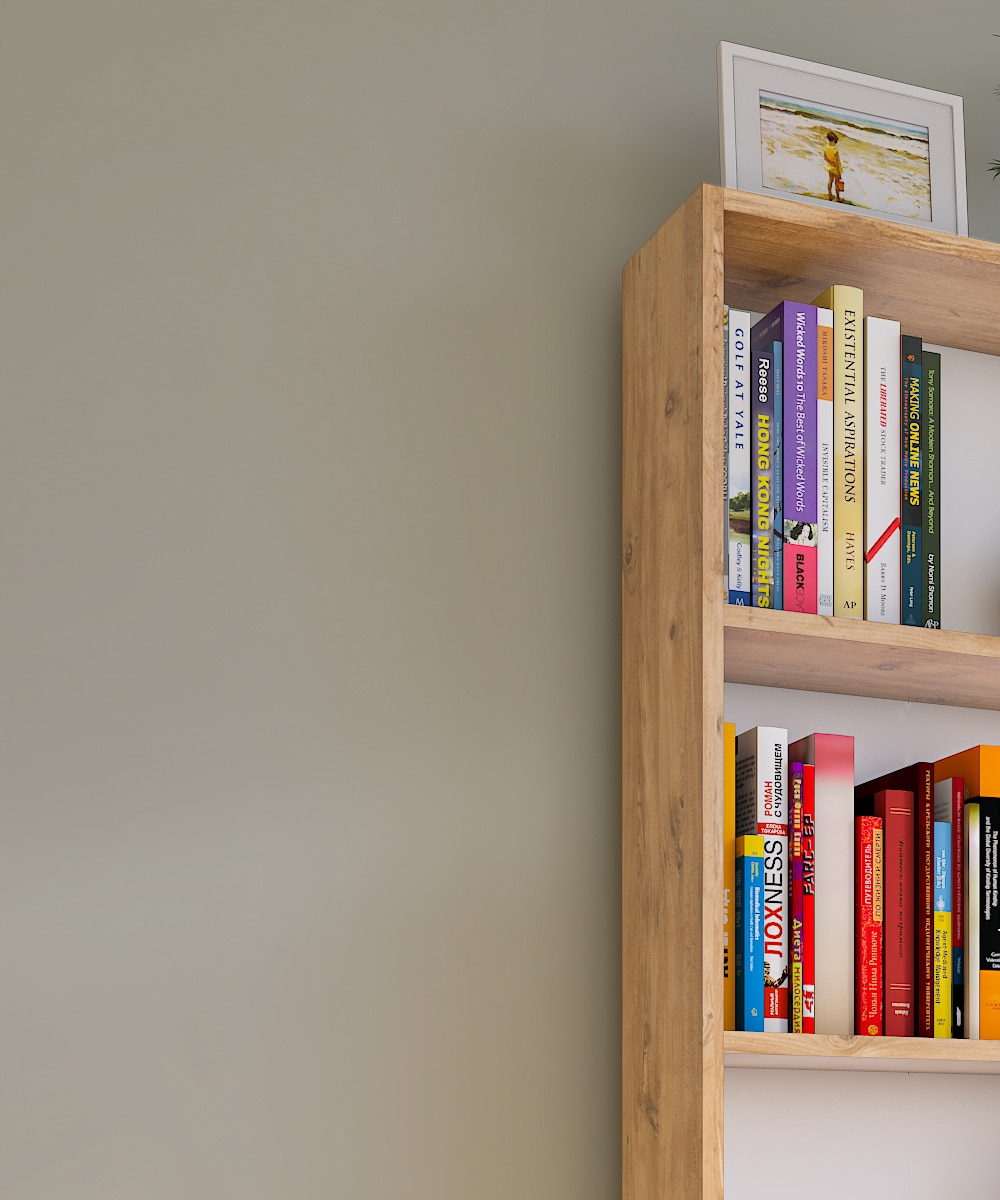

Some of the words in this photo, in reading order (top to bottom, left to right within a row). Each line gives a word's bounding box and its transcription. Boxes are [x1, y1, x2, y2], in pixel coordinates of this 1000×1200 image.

[796, 312, 806, 349] Wicked
[735, 328, 744, 371] GOLF
[796, 350, 806, 379] Words
[845, 310, 856, 405] EXISTENTIAL
[735, 380, 744, 401] AT
[758, 358, 770, 403] Reese
[927, 369, 935, 386] Tony
[797, 393, 806, 411] The
[880, 384, 888, 427] LIBERATED
[909, 378, 920, 419] MAKING
[735, 411, 744, 450] YALE
[795, 434, 806, 445] of
[797, 412, 806, 432] Best
[757, 413, 770, 471] HONG
[845, 411, 856, 503] ASPIRATIONS
[909, 422, 920, 468] ONLINE
[796, 446, 806, 481] Wicked
[757, 475, 770, 531] KONG
[796, 482, 806, 512] Words
[909, 471, 920, 506] NEWS
[927, 506, 935, 534] Beyond
[846, 532, 855, 571] HAYES
[927, 554, 935, 564] by
[757, 535, 770, 609] NIGHTS
[796, 554, 805, 590] BLACK
[844, 601, 857, 609] AP
[774, 743, 783, 808] ЧУДОВИЩЕМ
[763, 781, 773, 817] РОМАН
[863, 844, 872, 905] ПУТЕВОДИТЕЛЬ
[765, 841, 782, 957] ЛОХNESS
[874, 905, 881, 917] ПО
[793, 919, 804, 962] Диета
[793, 965, 803, 1033] милосердия
[868, 970, 877, 991] Нима
[868, 992, 878, 1019] Чокьи
